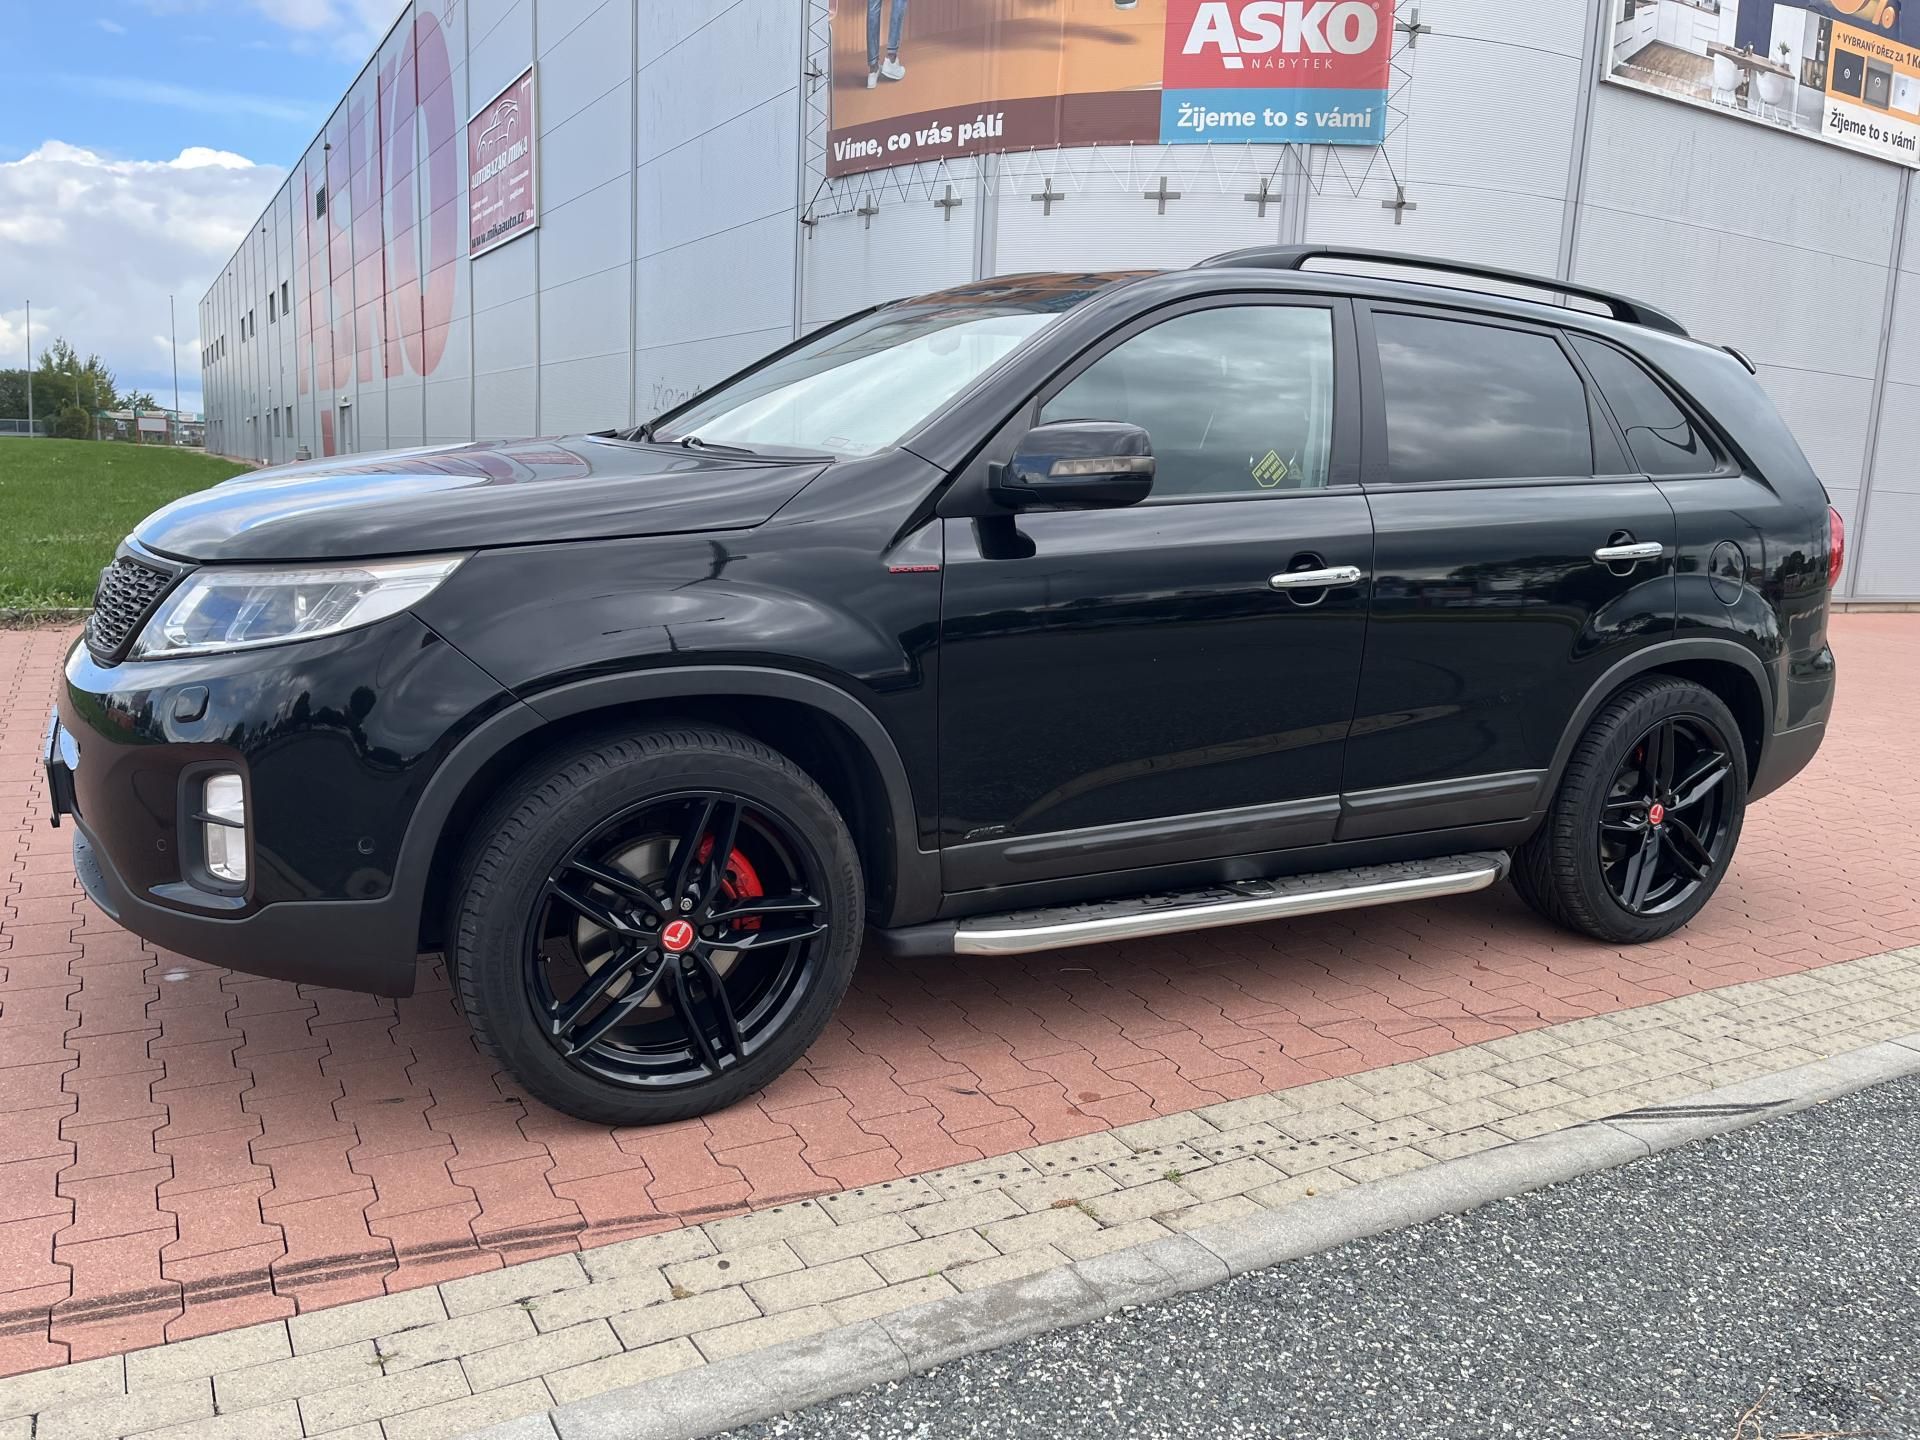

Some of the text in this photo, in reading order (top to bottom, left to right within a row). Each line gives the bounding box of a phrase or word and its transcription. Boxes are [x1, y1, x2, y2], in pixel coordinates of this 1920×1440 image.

[1182, 1, 1378, 55] ASKO
[1251, 56, 1334, 70] NÁBYTEK
[1842, 33, 1875, 54] VYBRANÝ
[1876, 44, 1895, 60] DŘEZ
[1894, 52, 1904, 63] ZA
[1906, 52, 1911, 65] 1
[1912, 54, 1920, 68] K
[833, 112, 1004, 161] Víme, co vás pálí
[1177, 102, 1371, 132] Žijeme to s vámi
[1829, 107, 1916, 151] Žijeme to s vámi
[842, 862, 857, 960] UNIROYAL
